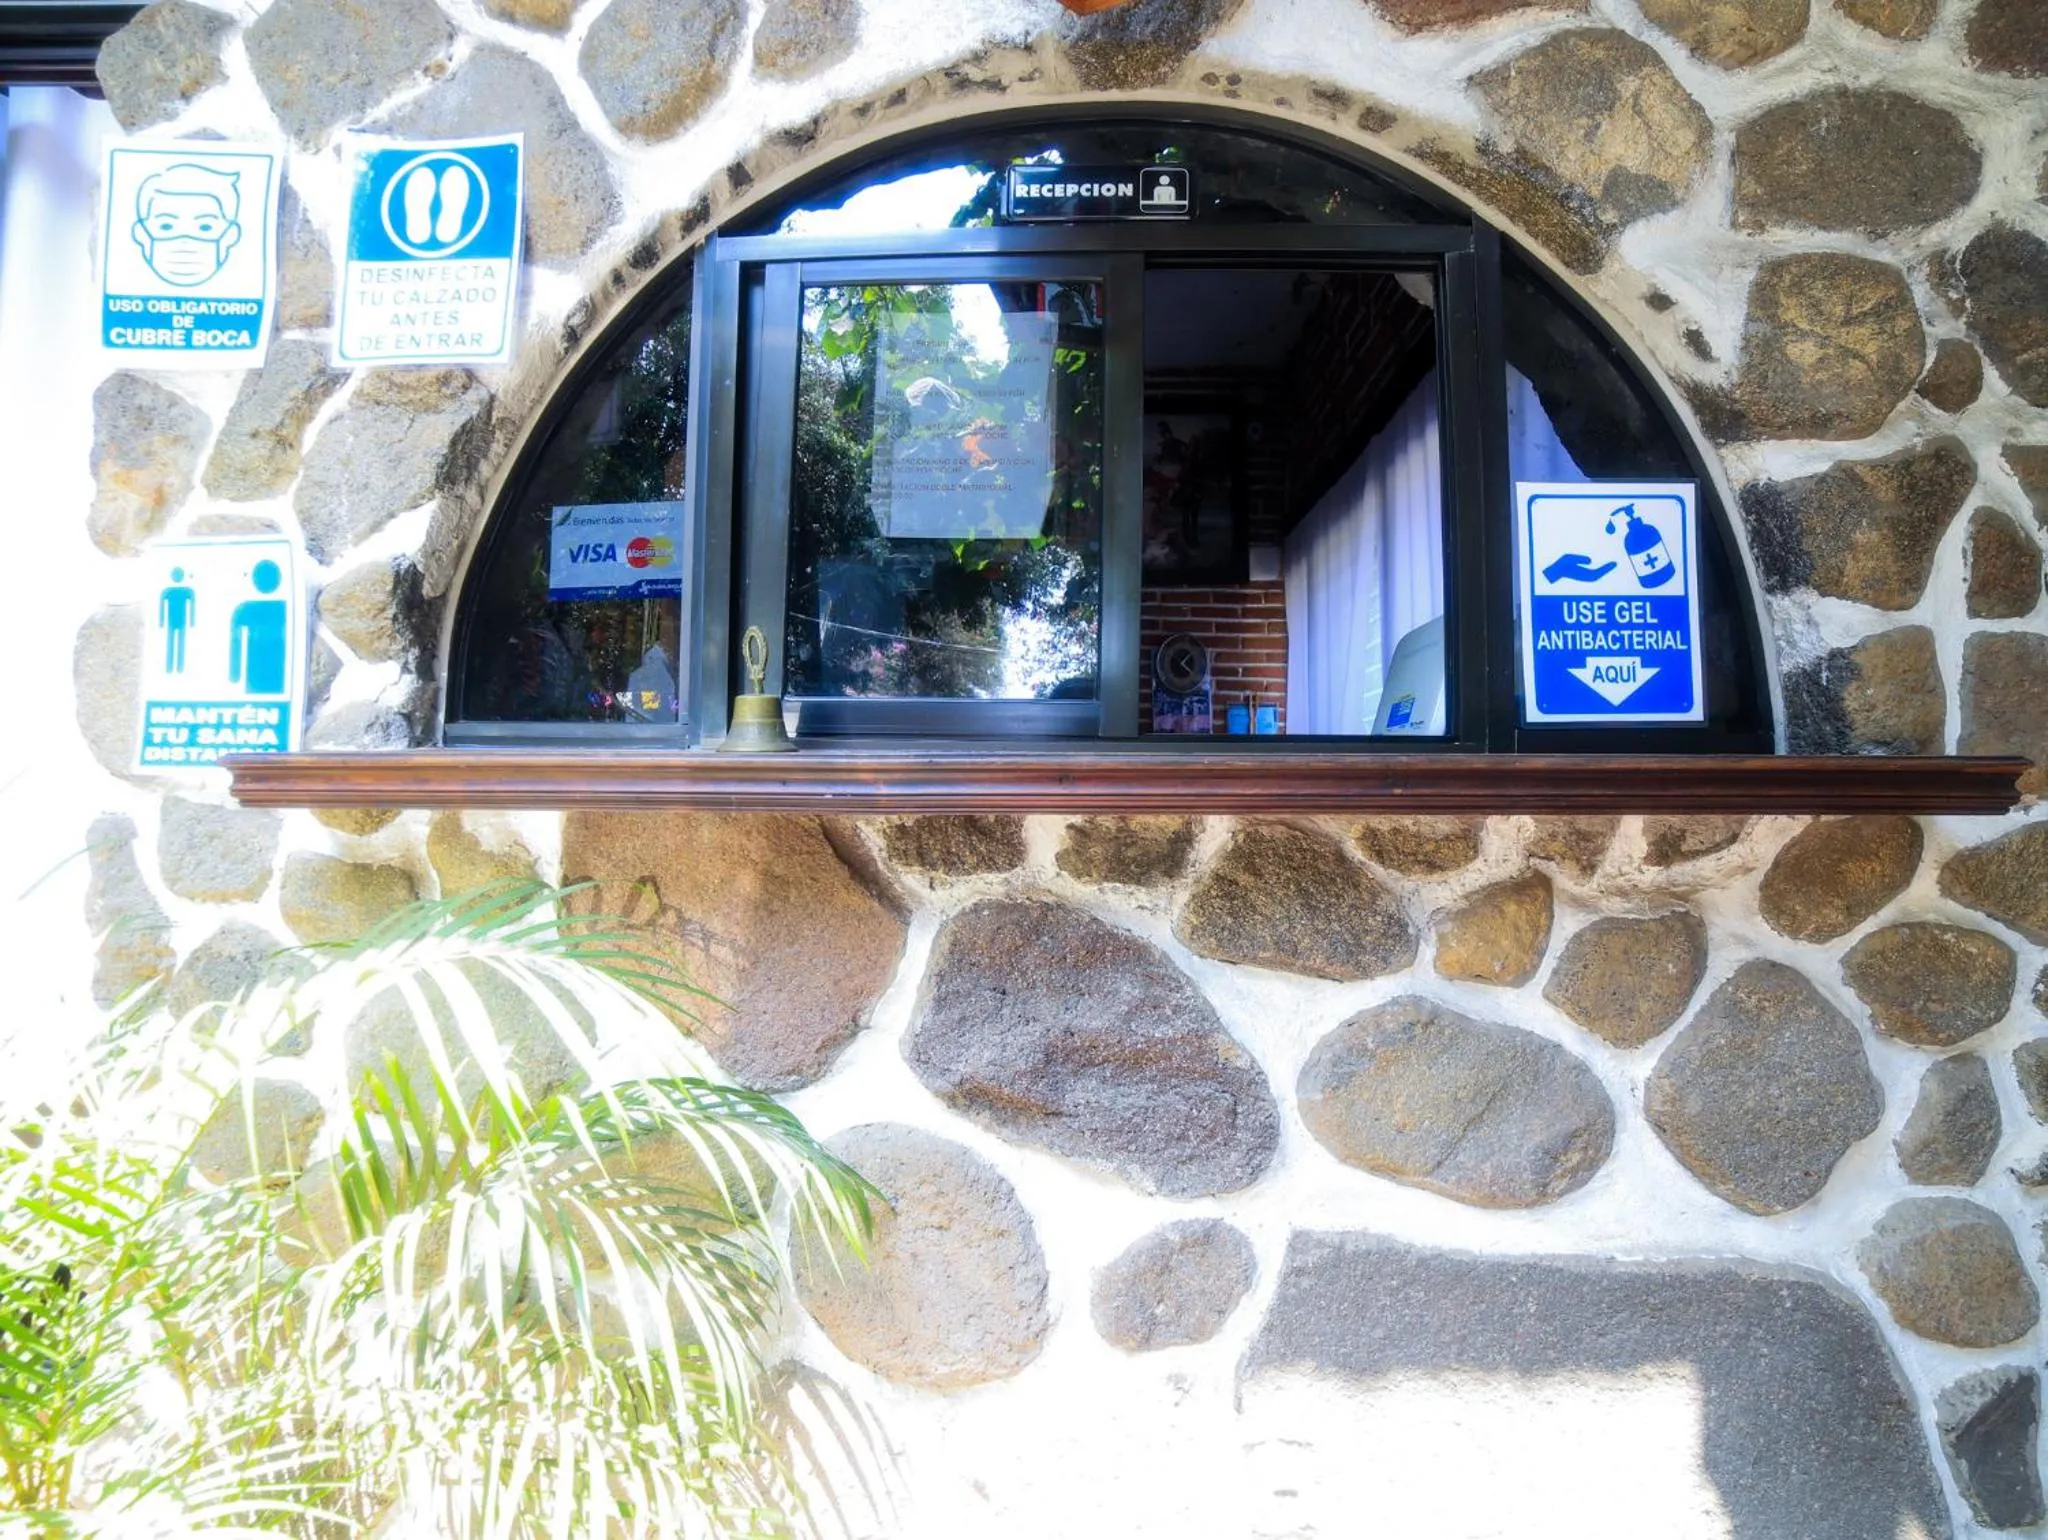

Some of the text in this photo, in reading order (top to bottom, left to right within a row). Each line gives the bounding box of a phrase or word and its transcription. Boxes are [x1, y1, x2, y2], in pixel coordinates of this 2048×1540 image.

[1015, 183, 1134, 198] RECEPCION
[360, 265, 496, 284] DESINFECTA
[357, 287, 496, 306] TU CALZADO
[109, 299, 258, 315] USO OBLIGATORIO
[172, 315, 195, 328] DE
[389, 310, 459, 326] ANTES
[110, 327, 251, 346] CUBRE BOCA
[359, 333, 483, 351] DE ENTRAR
[568, 543, 617, 564] VISA
[1563, 601, 1658, 624] USE GEL
[1537, 630, 1688, 650] ANTIBACTERIAL
[1592, 661, 1637, 684] AQUÍ
[151, 704, 279, 724] MANTÉN
[149, 727, 279, 744] TU SANA
[144, 747, 277, 761] DISTA
